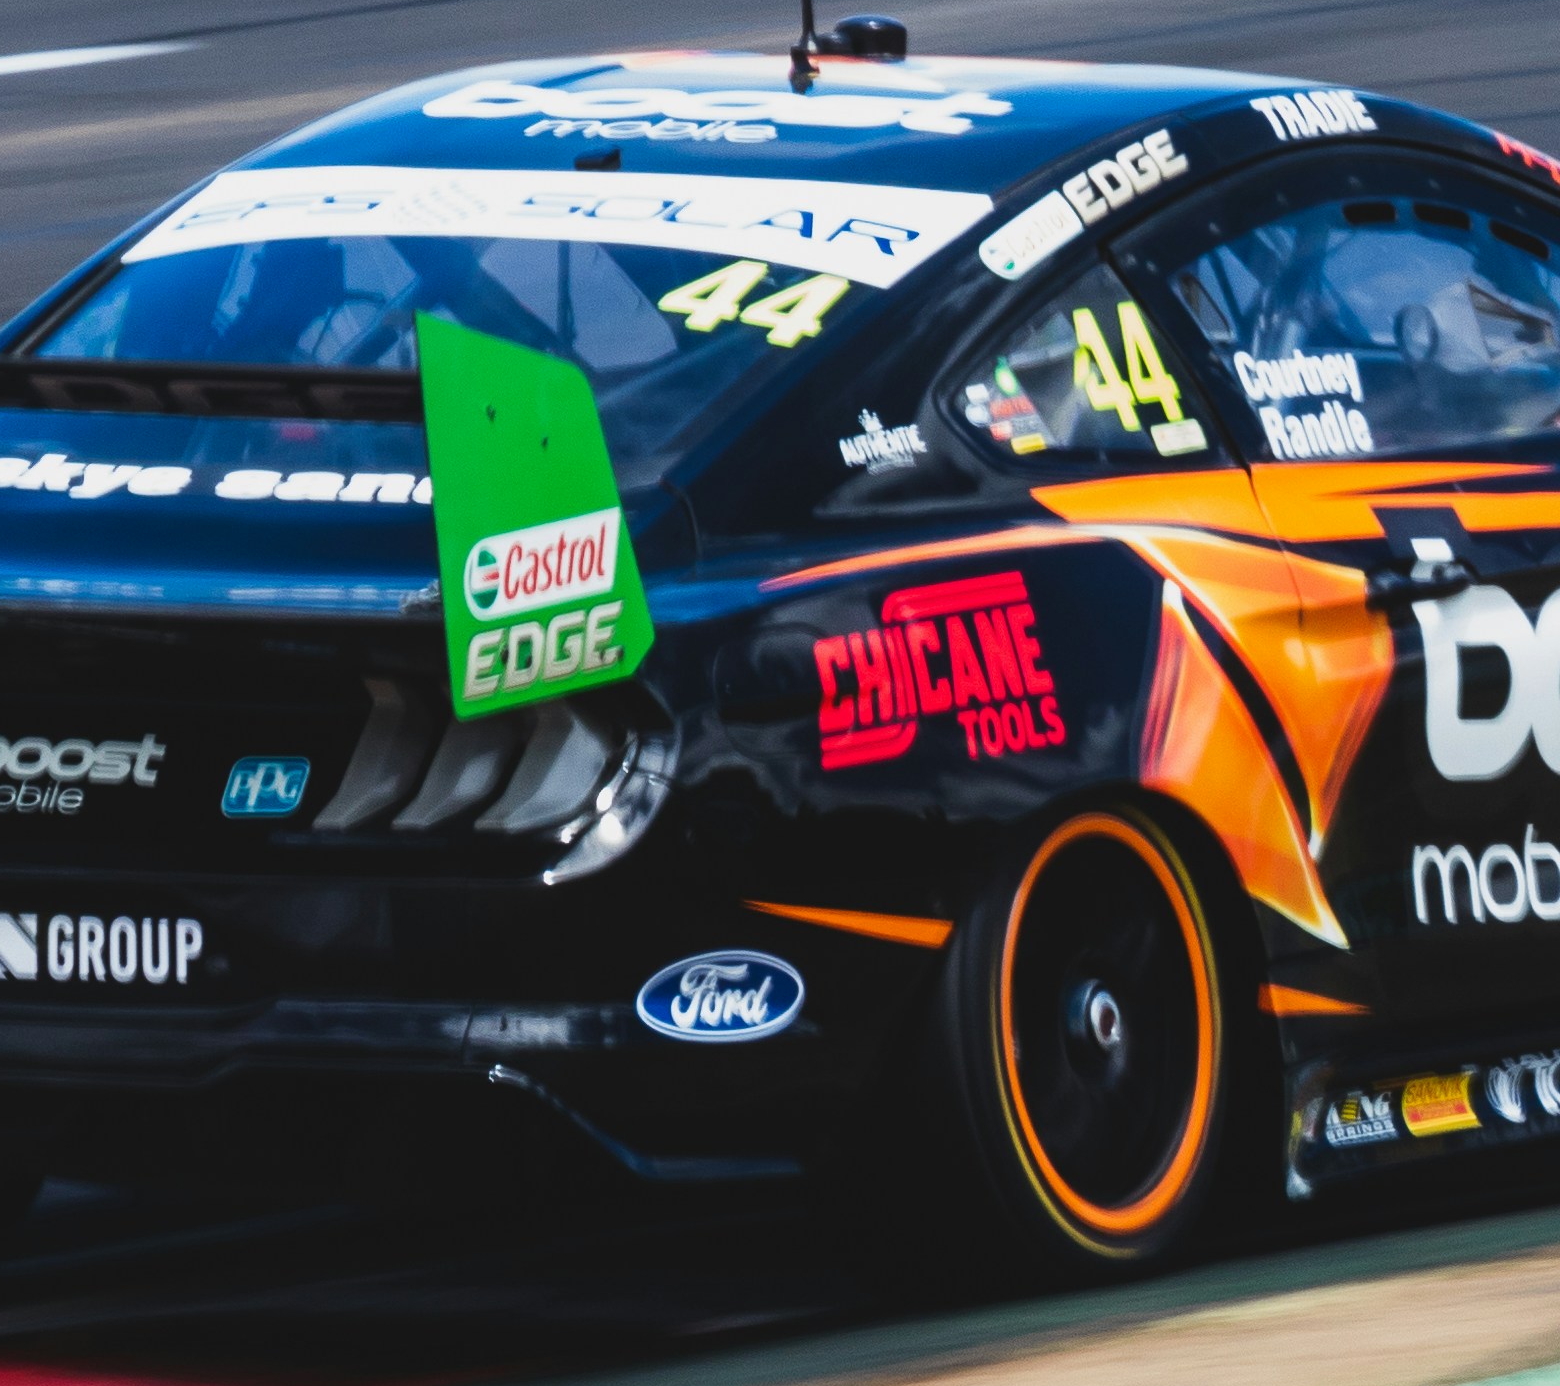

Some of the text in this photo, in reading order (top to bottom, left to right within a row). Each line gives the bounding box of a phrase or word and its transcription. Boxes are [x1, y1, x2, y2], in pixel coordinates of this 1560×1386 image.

[423, 79, 1014, 135] boost
[523, 117, 780, 144] mobile
[1248, 89, 1379, 142] TRADIE
[1062, 128, 1189, 226] EDGE
[508, 190, 922, 257] SOLAR
[657, 258, 851, 348] 44
[1073, 300, 1182, 431] 44
[1235, 348, 1364, 402] Courtney
[1260, 403, 1376, 460] Randle
[503, 538, 607, 604] Castrol
[463, 599, 625, 703] EDGE
[813, 598, 1056, 741] CHICANE
[956, 695, 1068, 761] TOOLS
[228, 762, 301, 811] PPG
[47, 914, 204, 985] GROUP
[670, 963, 773, 1029] Ford
[1325, 1117, 1397, 1142] SPRINGS
